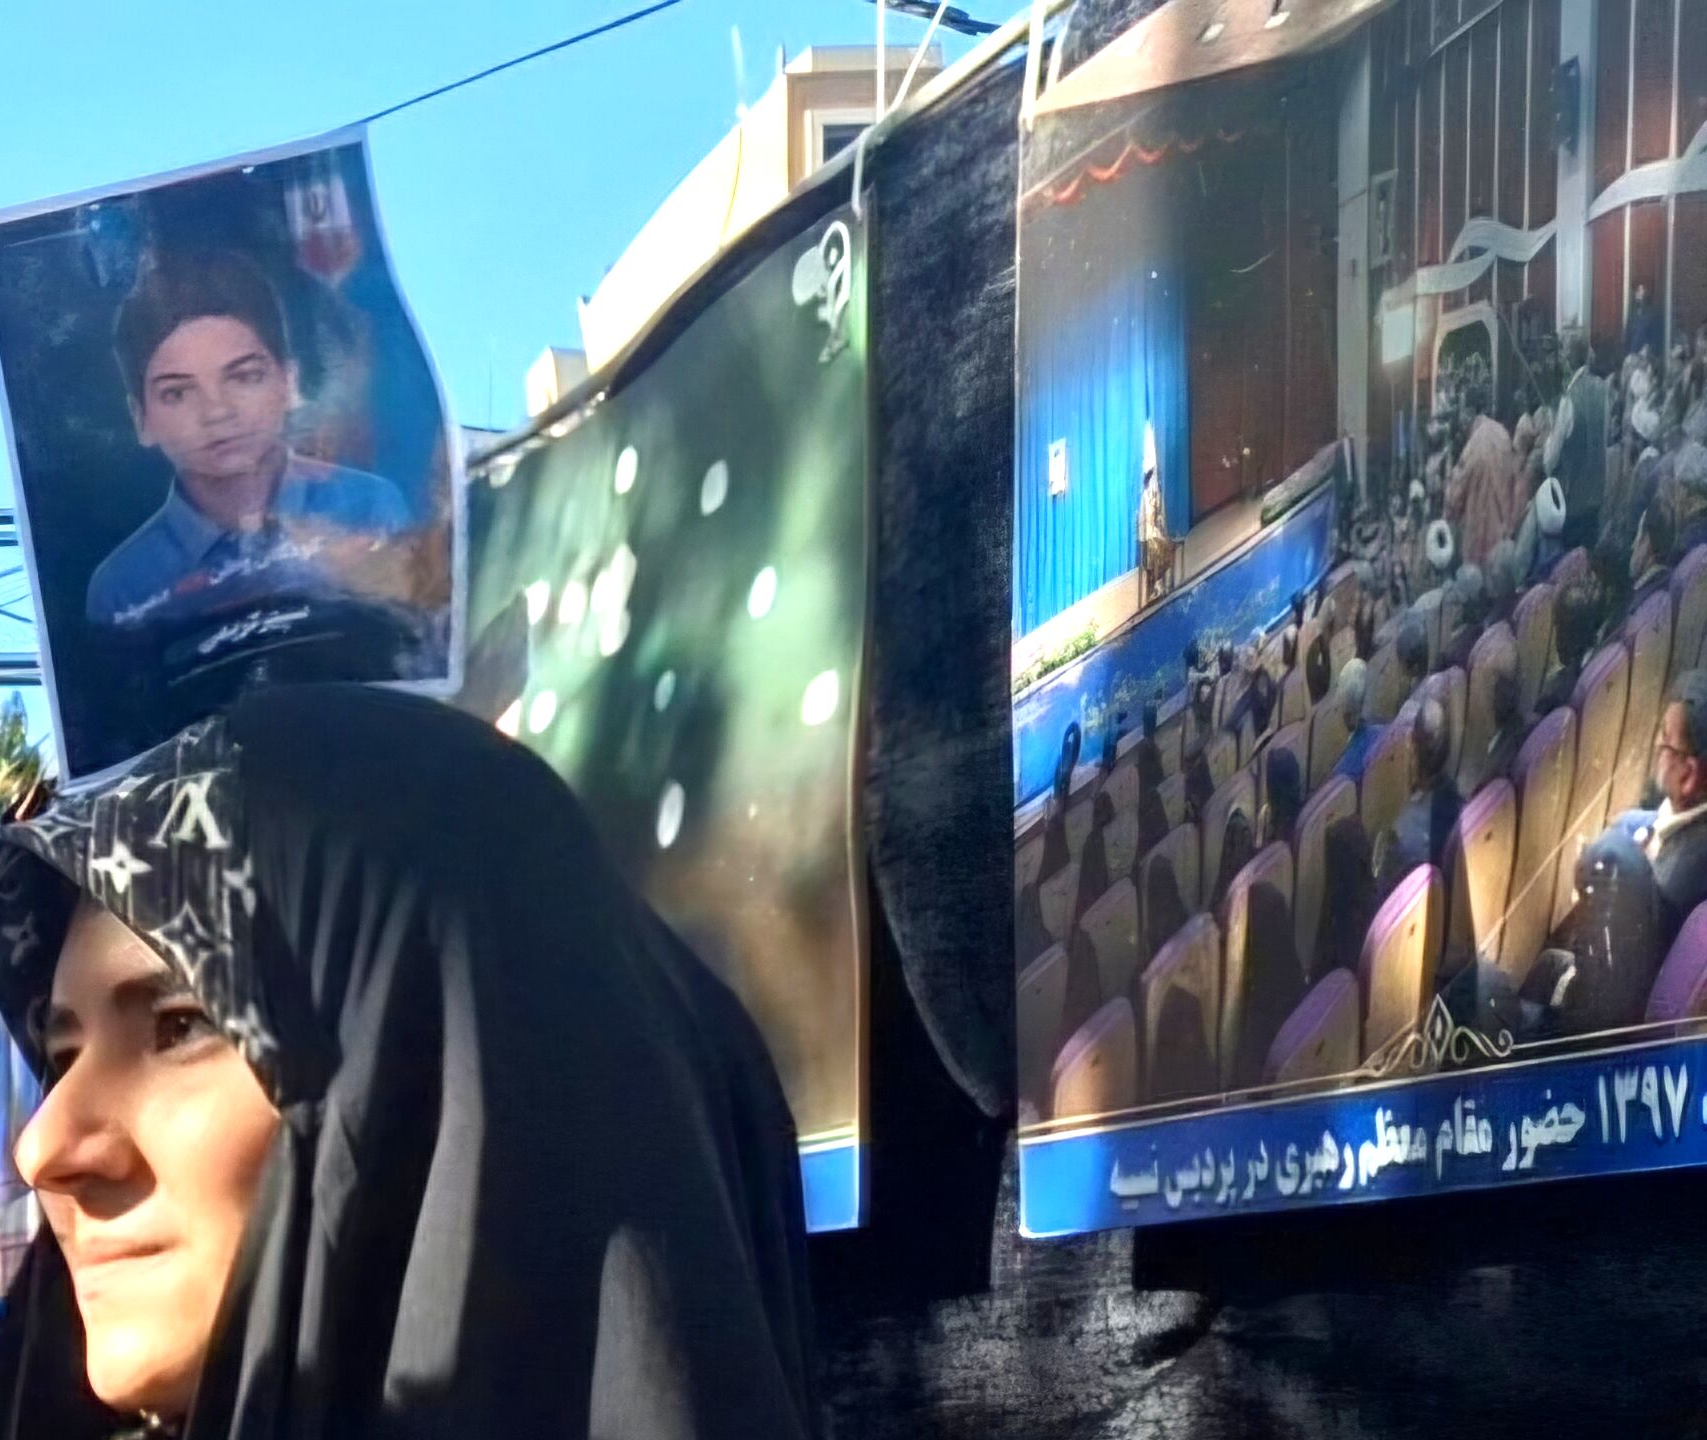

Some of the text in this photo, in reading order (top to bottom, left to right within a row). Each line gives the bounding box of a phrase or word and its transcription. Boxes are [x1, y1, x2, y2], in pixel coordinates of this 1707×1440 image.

[1436, 1095, 1494, 1182] مقام
[1501, 1088, 1586, 1172] حضور
[1597, 1062, 1688, 1144] ۱۳۹۷
[1241, 1139, 1269, 1201] در
[1274, 1128, 1356, 1197] رهبری
[1357, 1106, 1428, 1188] معظم
